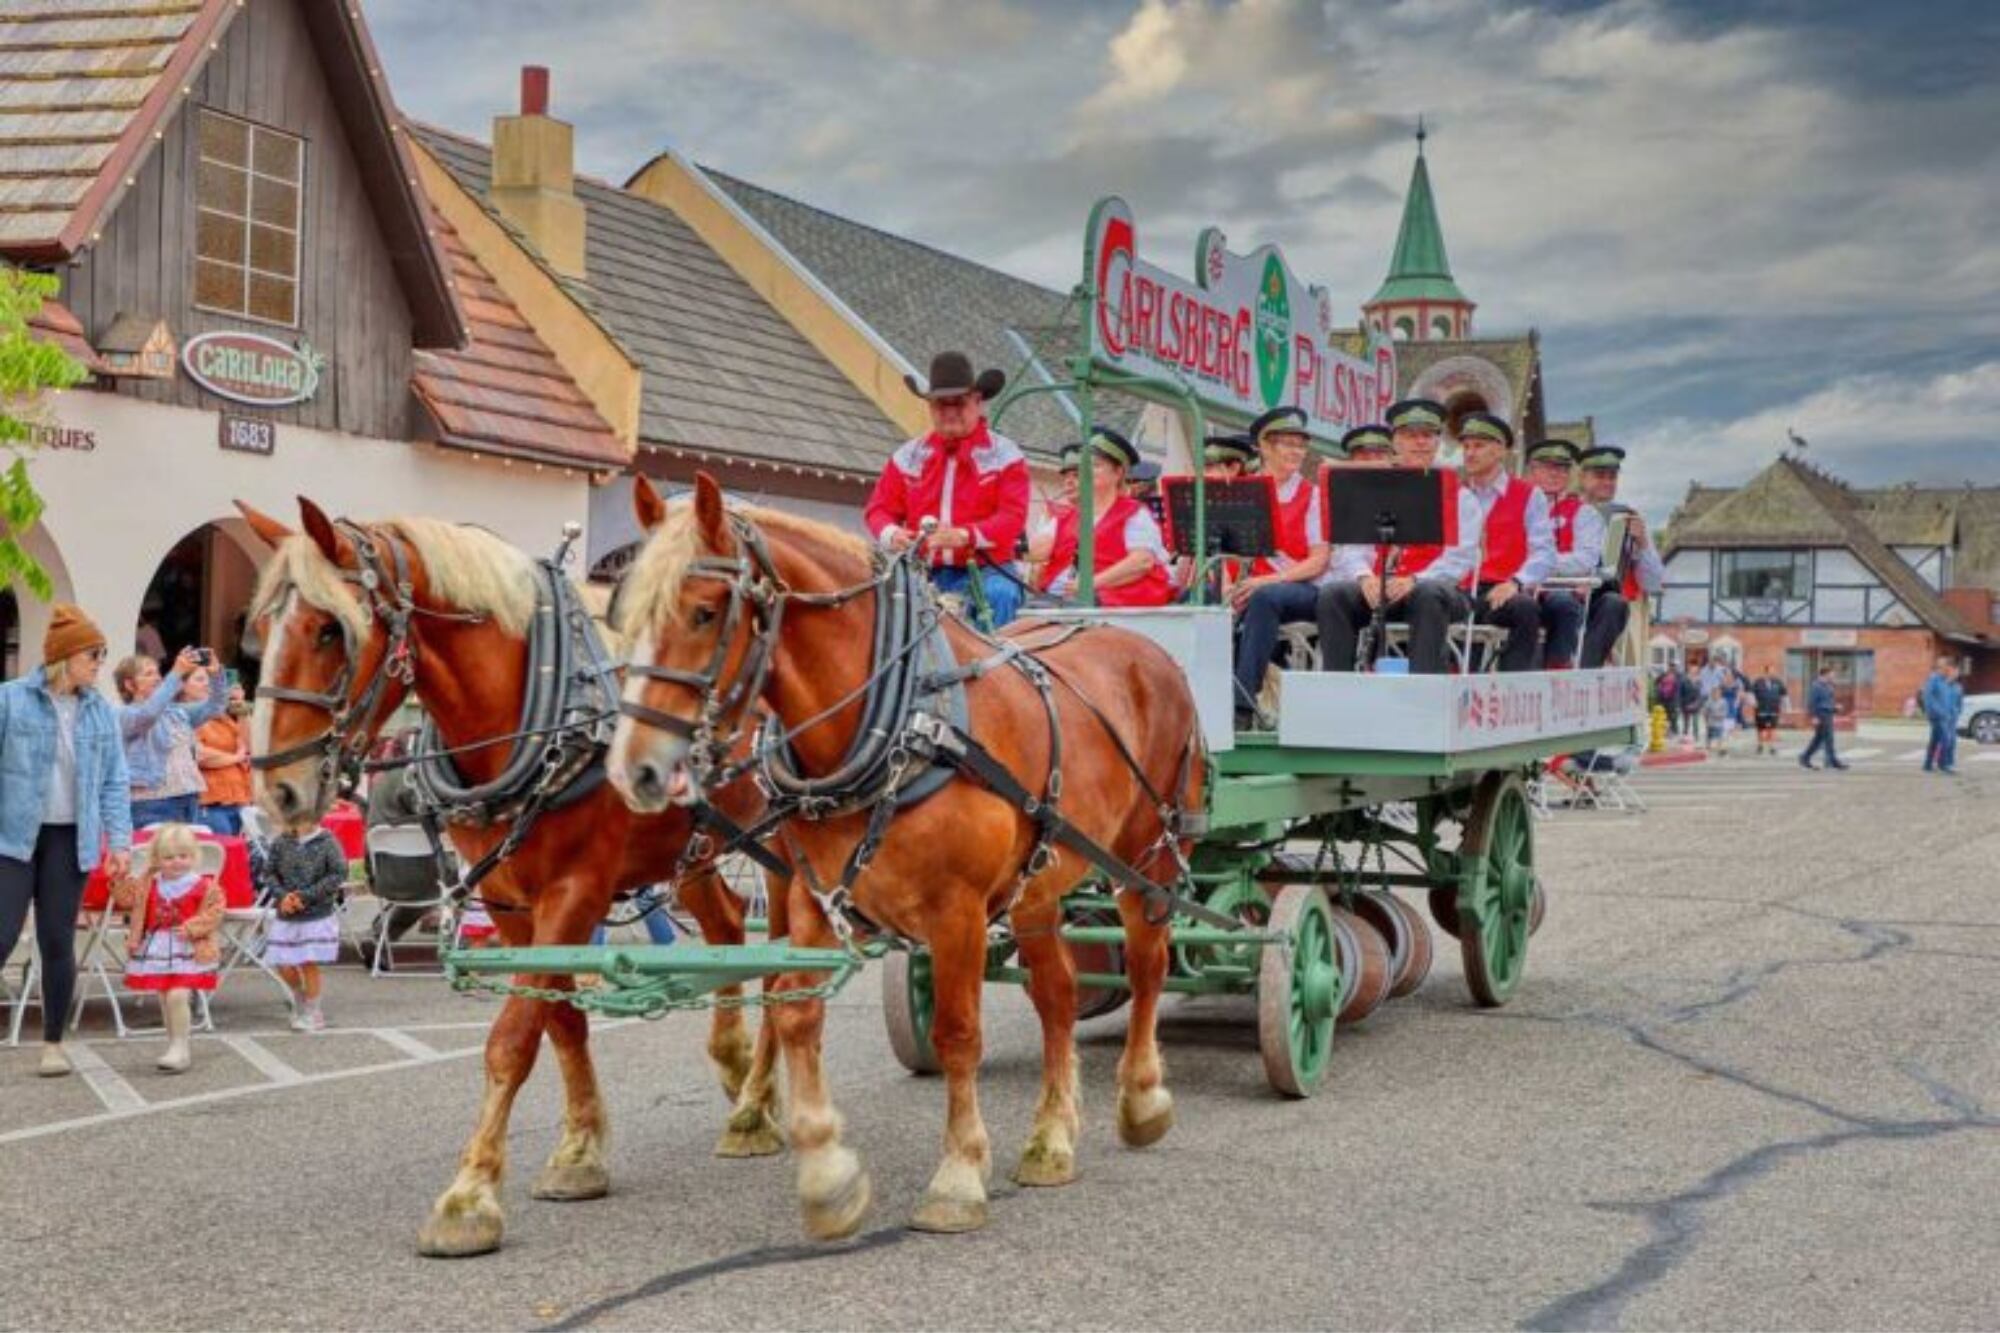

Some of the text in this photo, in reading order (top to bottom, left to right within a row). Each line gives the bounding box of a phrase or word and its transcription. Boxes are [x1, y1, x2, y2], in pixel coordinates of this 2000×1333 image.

[1097, 217, 1251, 397] CARLSBERG
[21, 421, 95, 451] TIQUES
[230, 420, 268, 449] 1683
